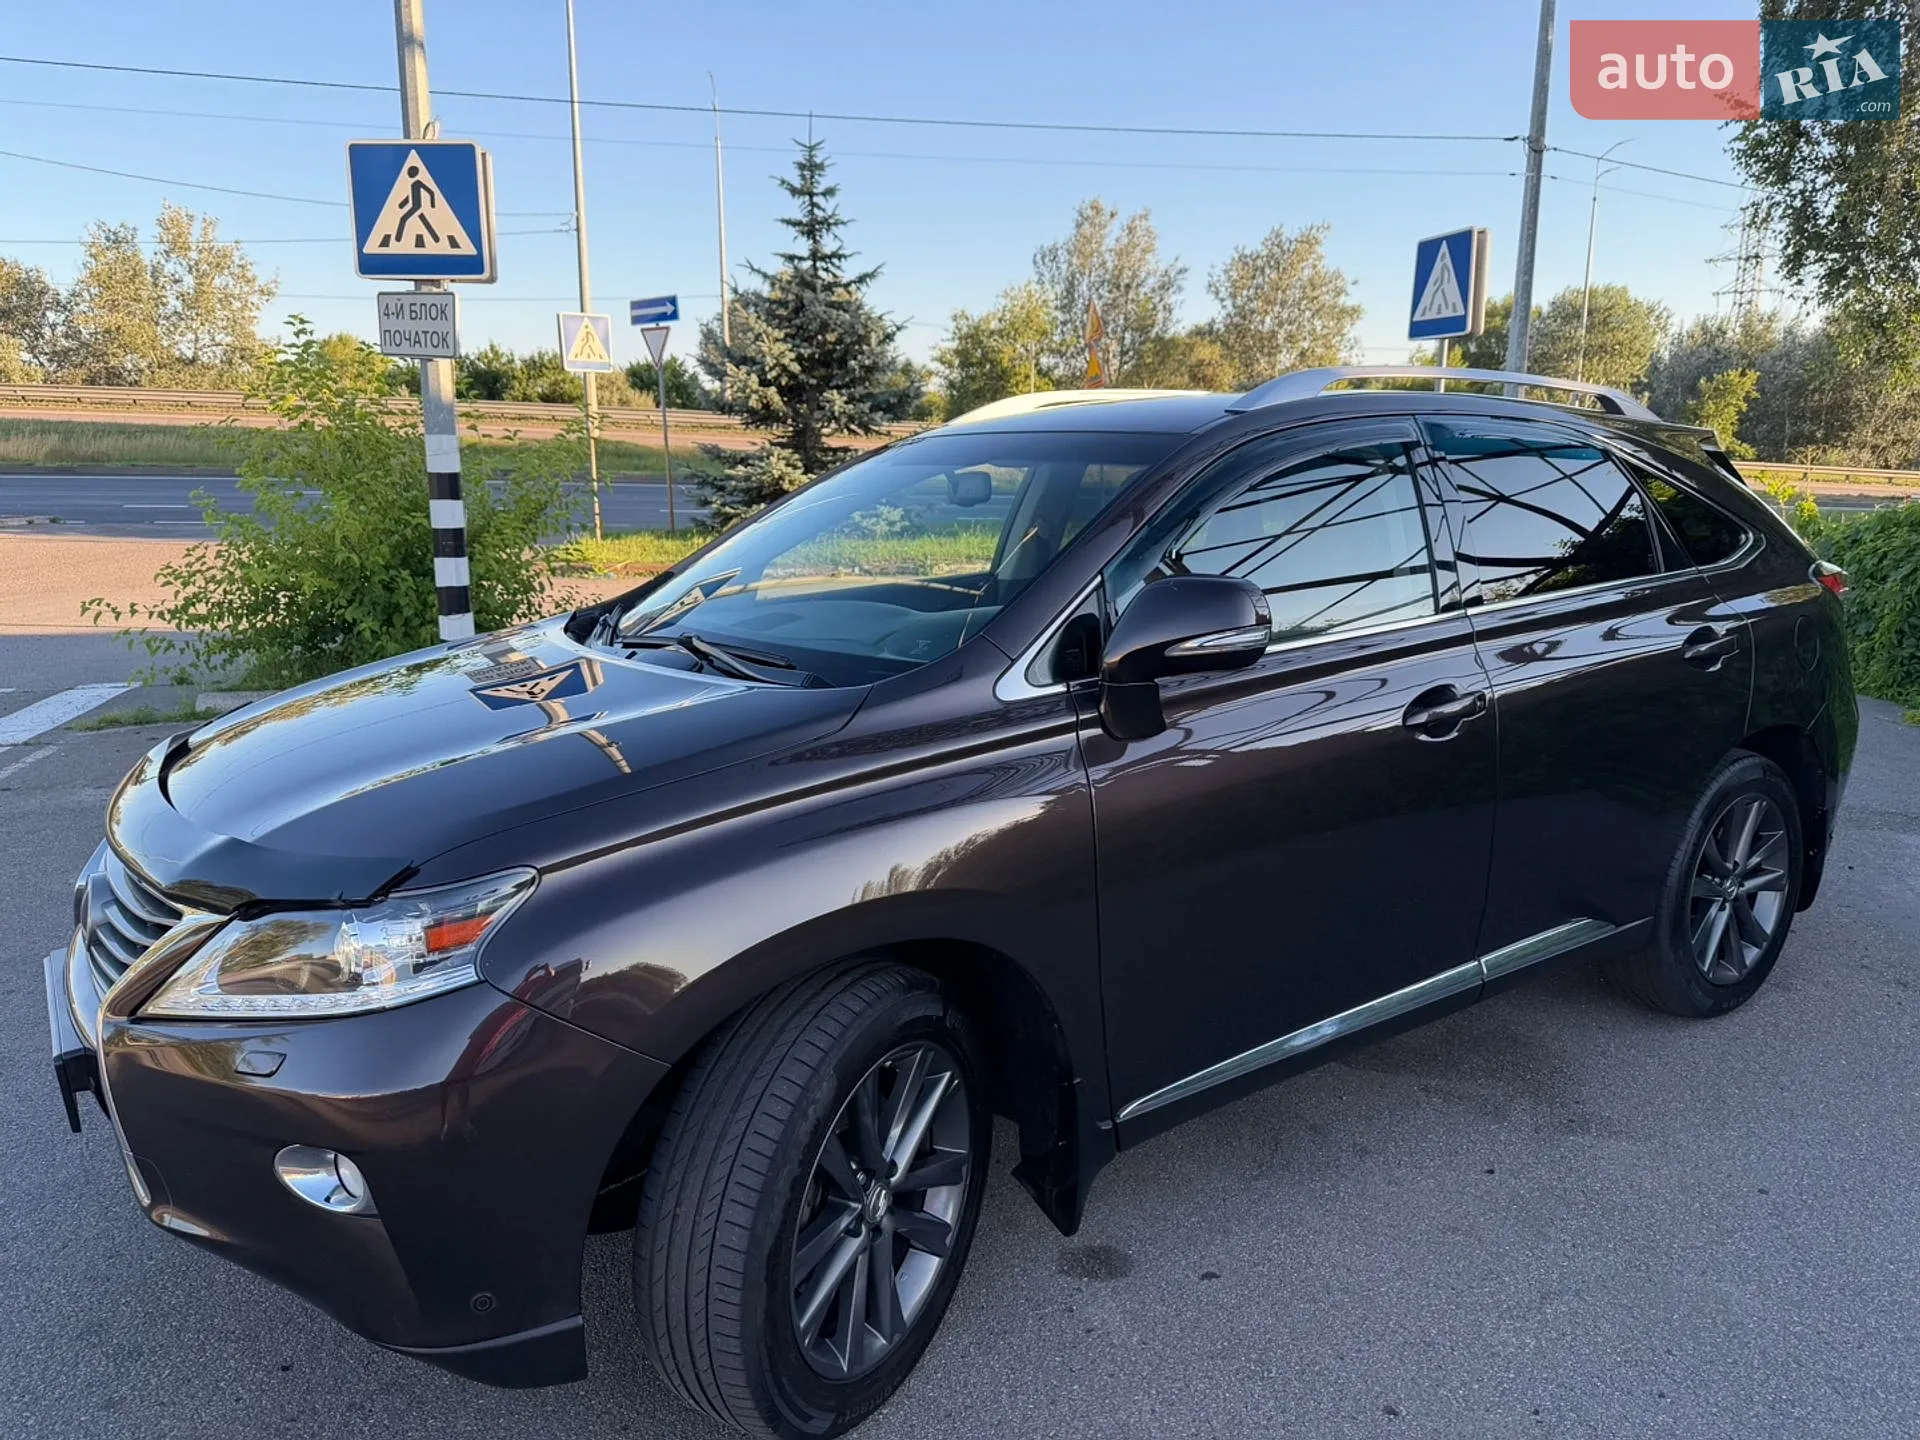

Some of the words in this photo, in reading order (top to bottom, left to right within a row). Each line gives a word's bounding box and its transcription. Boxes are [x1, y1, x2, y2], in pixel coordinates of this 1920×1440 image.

[383, 298, 405, 320] 4-Й
[409, 302, 449, 321] БЛОК
[383, 329, 450, 349] ПОЧАТОК
